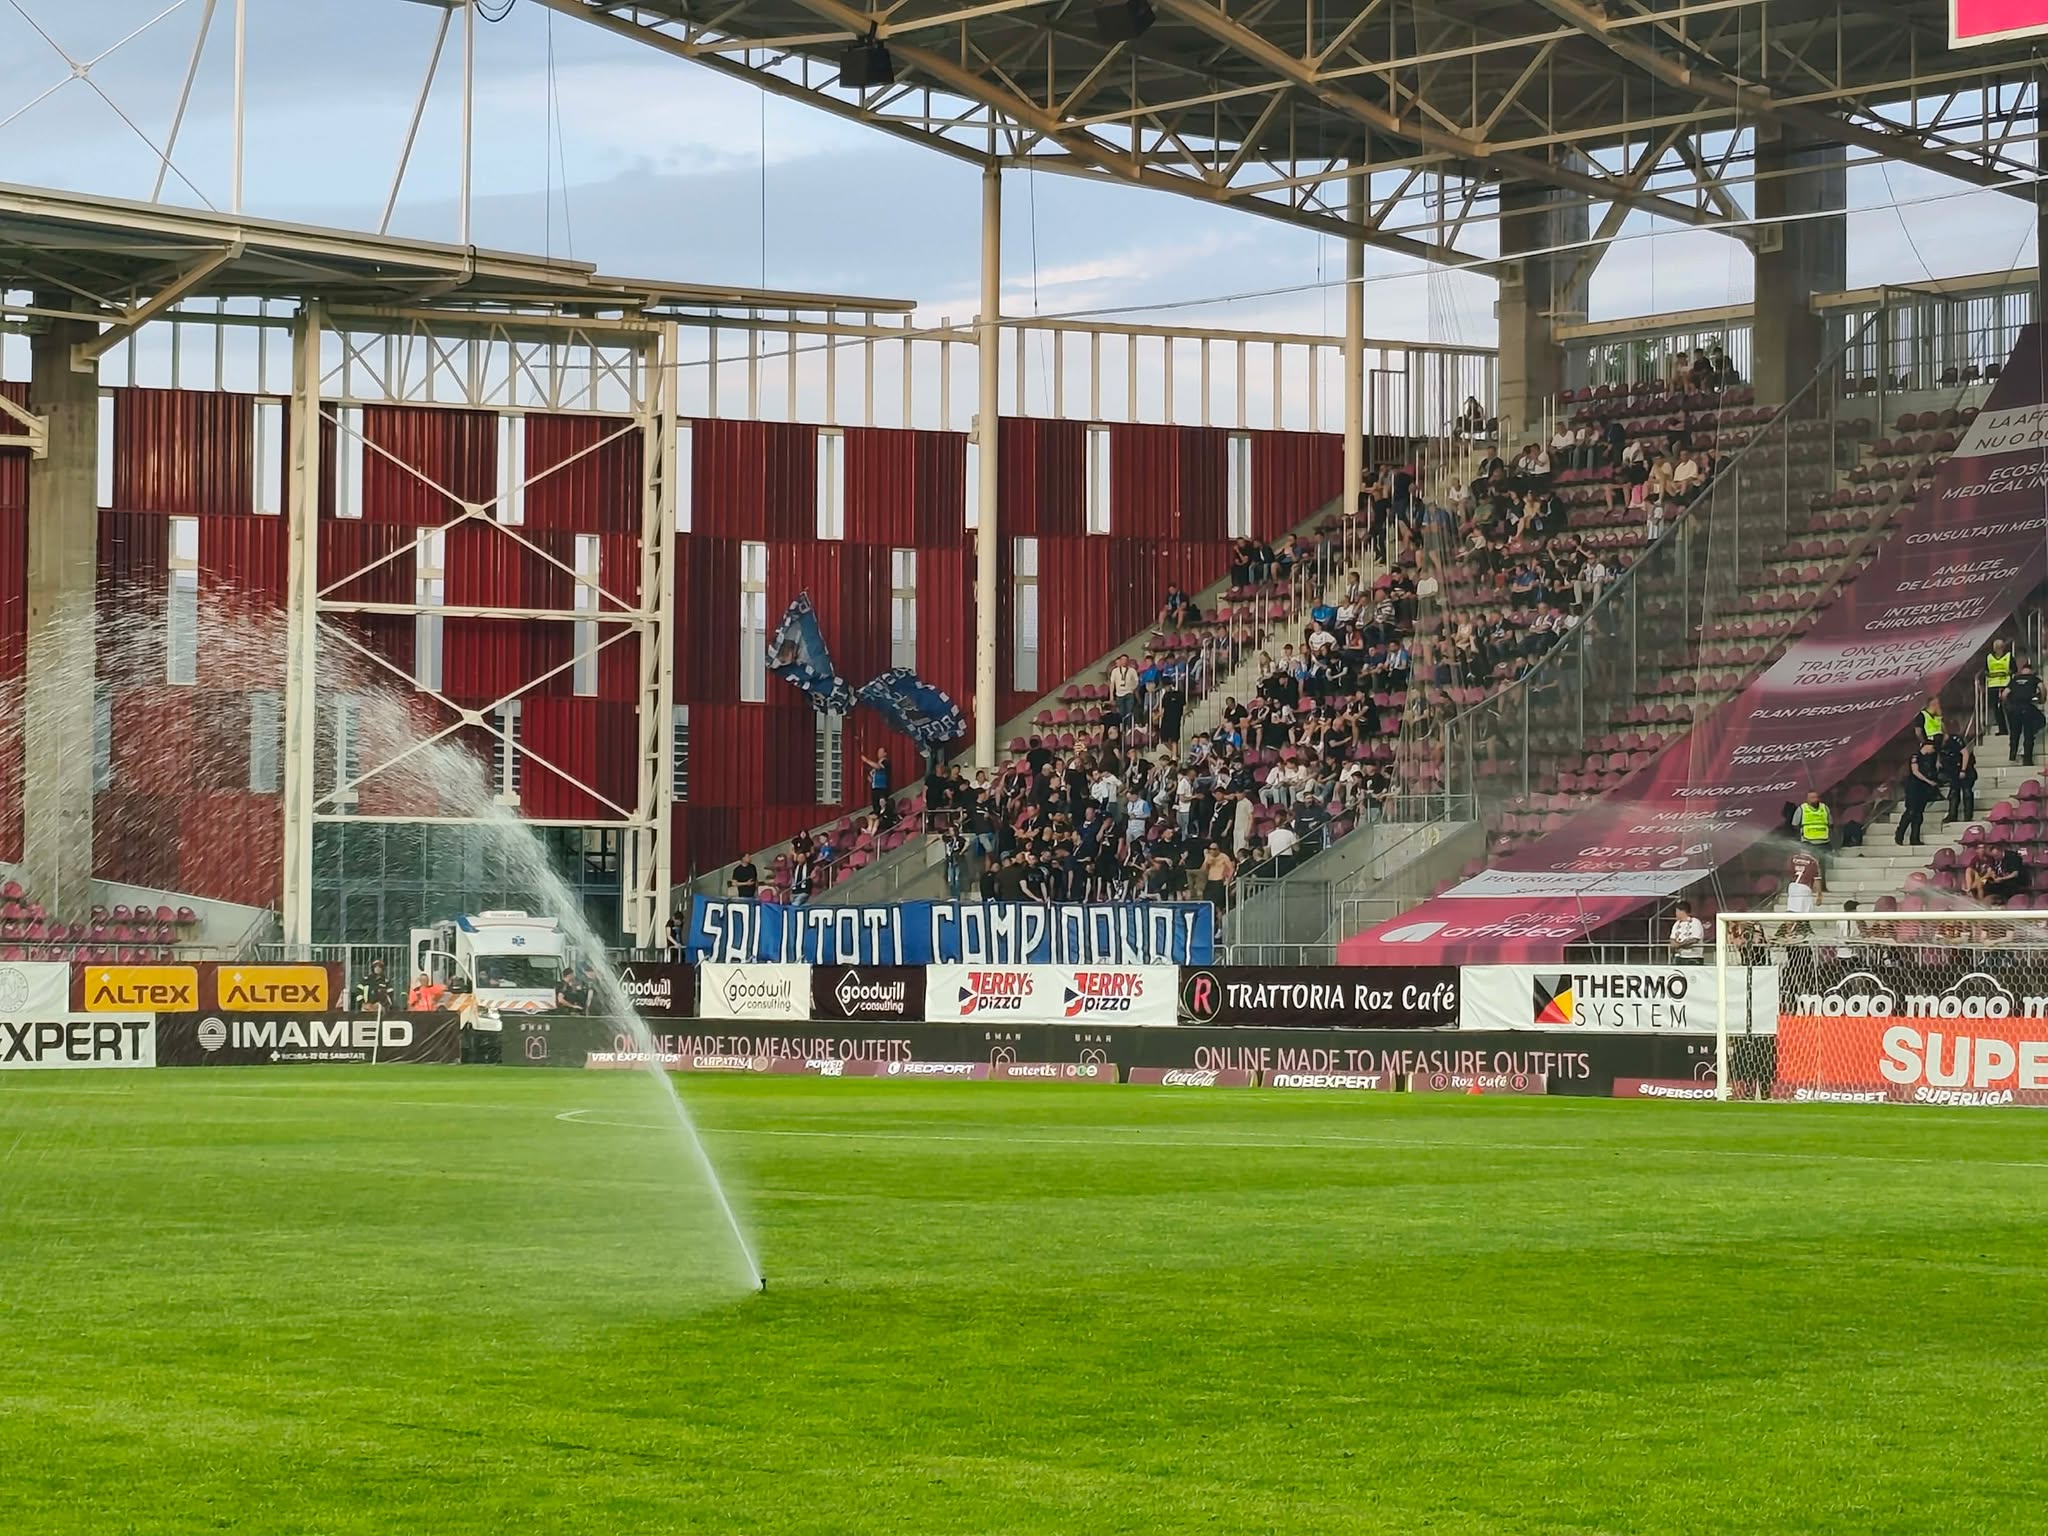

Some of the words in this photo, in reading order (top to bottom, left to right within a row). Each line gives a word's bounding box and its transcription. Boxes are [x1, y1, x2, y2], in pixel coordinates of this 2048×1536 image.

[1988, 416, 2010, 429] LA
[1975, 436, 2006, 450] NU
[2009, 433, 2025, 445] O
[1942, 479, 2023, 500] MEDICAL
[1932, 558, 2004, 577] ANALIZE
[1896, 578, 1920, 592] DE
[1921, 566, 2020, 590] LABORATOR
[1865, 606, 1985, 630] CHIRURGICALE
[1841, 634, 1958, 657] ONCOLOGIE
[1793, 671, 1852, 685] 100%
[1749, 708, 1796, 719] PLAN
[1671, 784, 1732, 797] TUMOR
[1734, 781, 1798, 795] BOARD
[1628, 825, 1656, 834] DE
[1504, 912, 1601, 925] Clinicile
[1441, 923, 1577, 938] affidea
[622, 978, 671, 996] goodwill
[729, 979, 791, 1001] goodwill
[842, 981, 905, 1001] goodwill
[1574, 970, 1688, 1001] THERMO
[978, 996, 1021, 1011] pizza
[1194, 977, 1213, 1014] R
[1226, 983, 1345, 1010] TRATTORIA
[1354, 983, 1393, 1010] Roz
[1402, 982, 1456, 1013] Café
[747, 998, 792, 1012] consulting
[860, 999, 904, 1014] consulting
[1084, 997, 1131, 1013] pizza
[1574, 1002, 1688, 1028] SYSTEM
[0, 1022, 150, 1062] XPERT
[233, 1019, 414, 1048] IMAMED
[678, 1035, 724, 1057] MADE
[727, 1036, 751, 1058] TO
[755, 1037, 835, 1060] MEASURE
[839, 1038, 912, 1062] OUTFITS
[1879, 1025, 2048, 1089] SUPE
[693, 1056, 753, 1070] CARPATINA
[805, 1059, 844, 1069] POWER
[1194, 1046, 1271, 1071] ONLINE
[1277, 1047, 1340, 1072] MADE
[1344, 1049, 1374, 1072] TO
[1381, 1050, 1486, 1074] MEASURE
[1493, 1050, 1590, 1079] OUTFITS
[1162, 1068, 1221, 1087] Coca-Cola
[1273, 1073, 1381, 1090] MOBEXPERT
[1451, 1075, 1474, 1087] Roz
[1477, 1075, 1508, 1088] Café
[1638, 1083, 1733, 1099] SUPERSCOE
[1794, 1088, 1888, 1103] SUPERBET
[1914, 1086, 2014, 1106] SUPERLIGA
